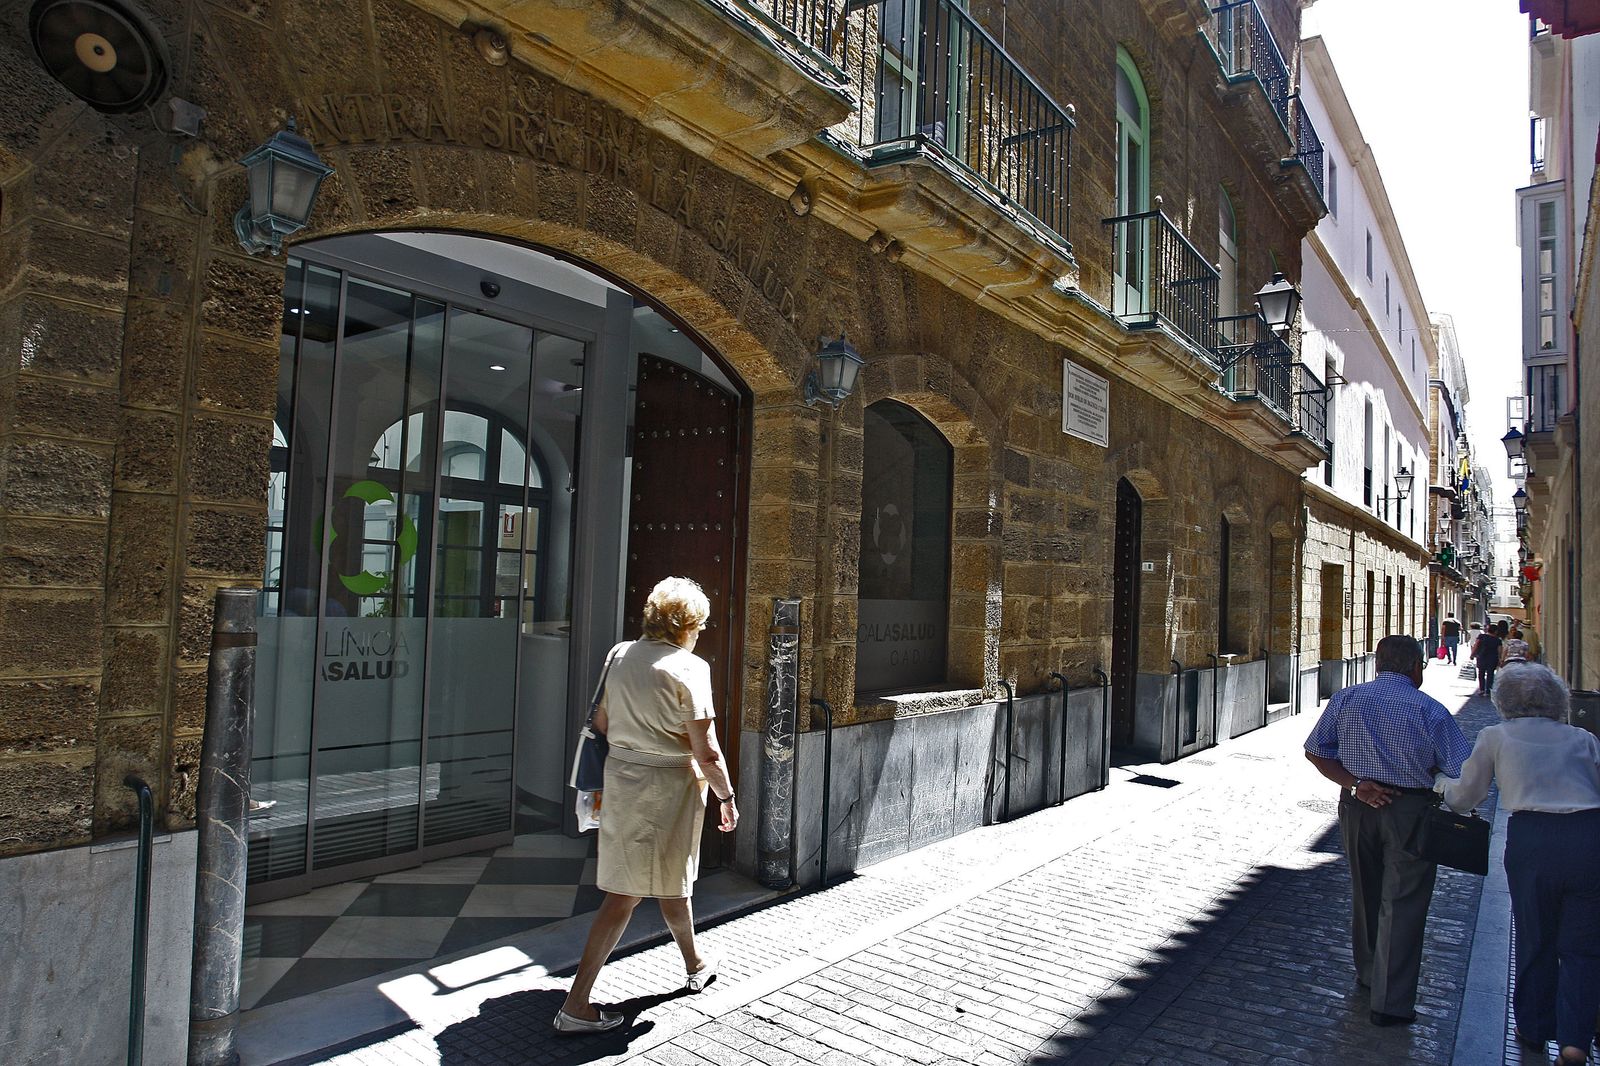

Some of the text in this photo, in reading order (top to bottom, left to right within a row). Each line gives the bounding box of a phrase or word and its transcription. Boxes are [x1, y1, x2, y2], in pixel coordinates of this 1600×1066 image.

[299, 93, 796, 323] NTRA SRA DE LA SALUD
